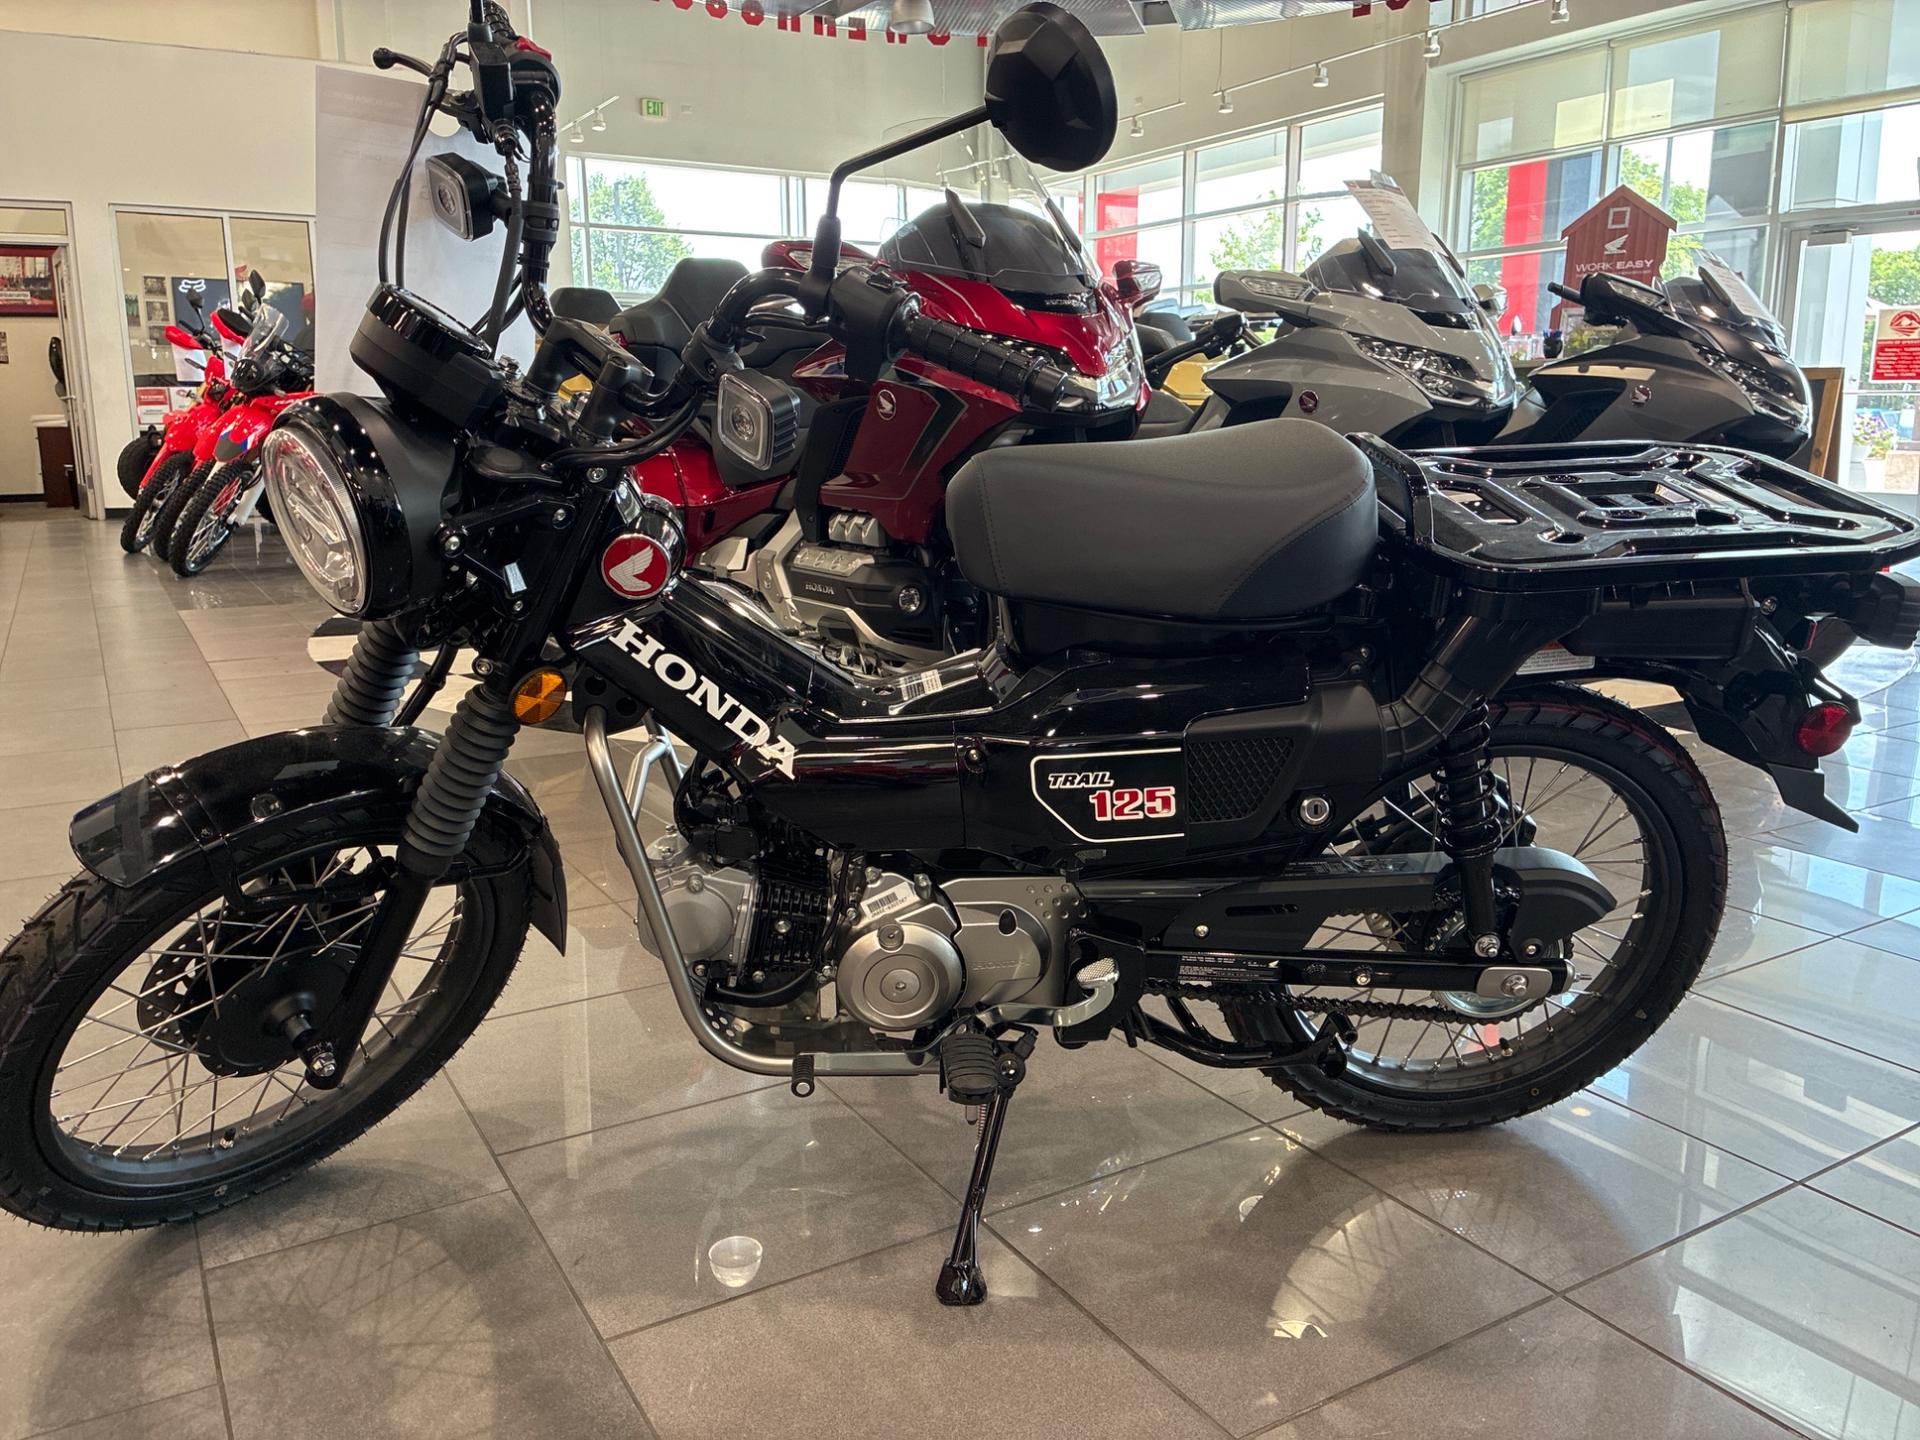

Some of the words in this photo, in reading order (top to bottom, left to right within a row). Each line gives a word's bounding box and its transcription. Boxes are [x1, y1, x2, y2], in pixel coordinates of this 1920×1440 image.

[646, 100, 664, 117] EXIT
[1575, 262, 1612, 272] WORK
[1616, 259, 1654, 270] EASY
[805, 583, 835, 595] HONDA
[608, 617, 796, 780] HONDA
[1048, 771, 1114, 789] TRAIL
[1089, 786, 1176, 821] 125
